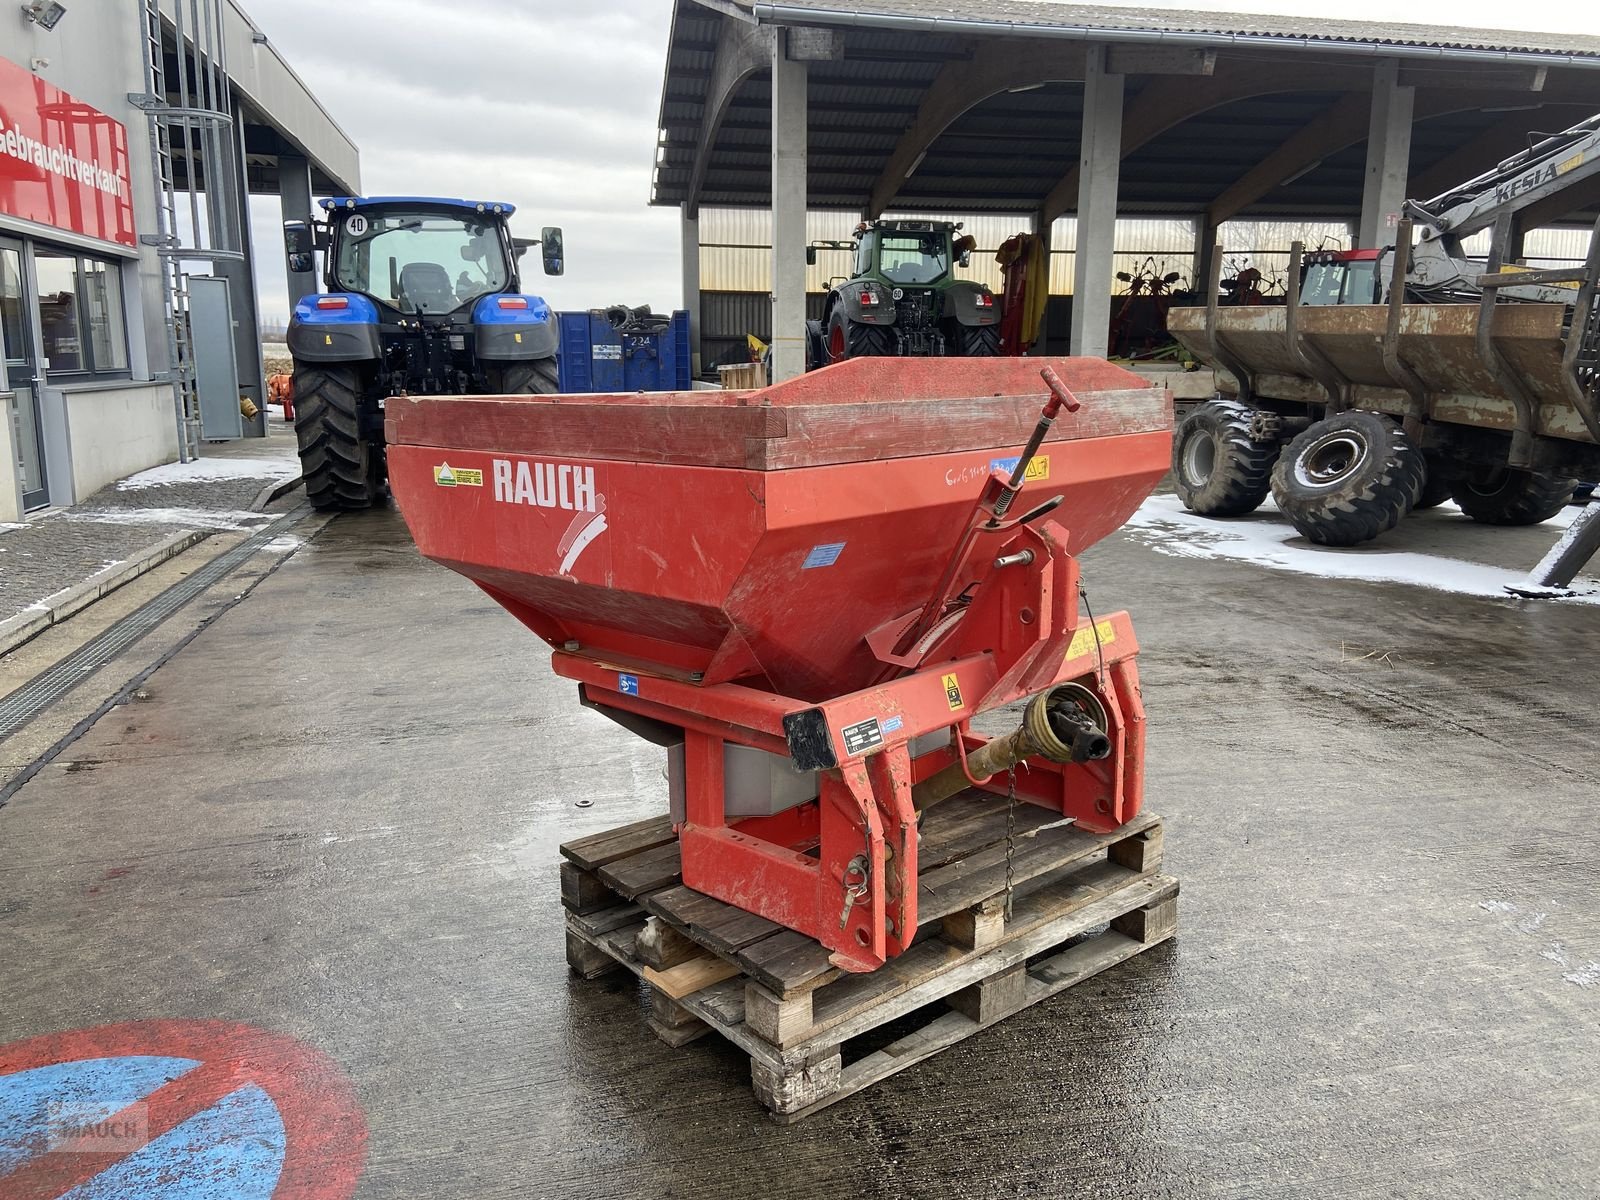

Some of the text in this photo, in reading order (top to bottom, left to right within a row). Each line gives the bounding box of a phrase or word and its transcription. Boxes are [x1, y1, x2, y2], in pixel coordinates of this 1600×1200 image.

[351, 218, 363, 232] 40
[893, 289, 902, 299] 60
[631, 336, 651, 347] 224
[492, 458, 597, 513] RAUCH
